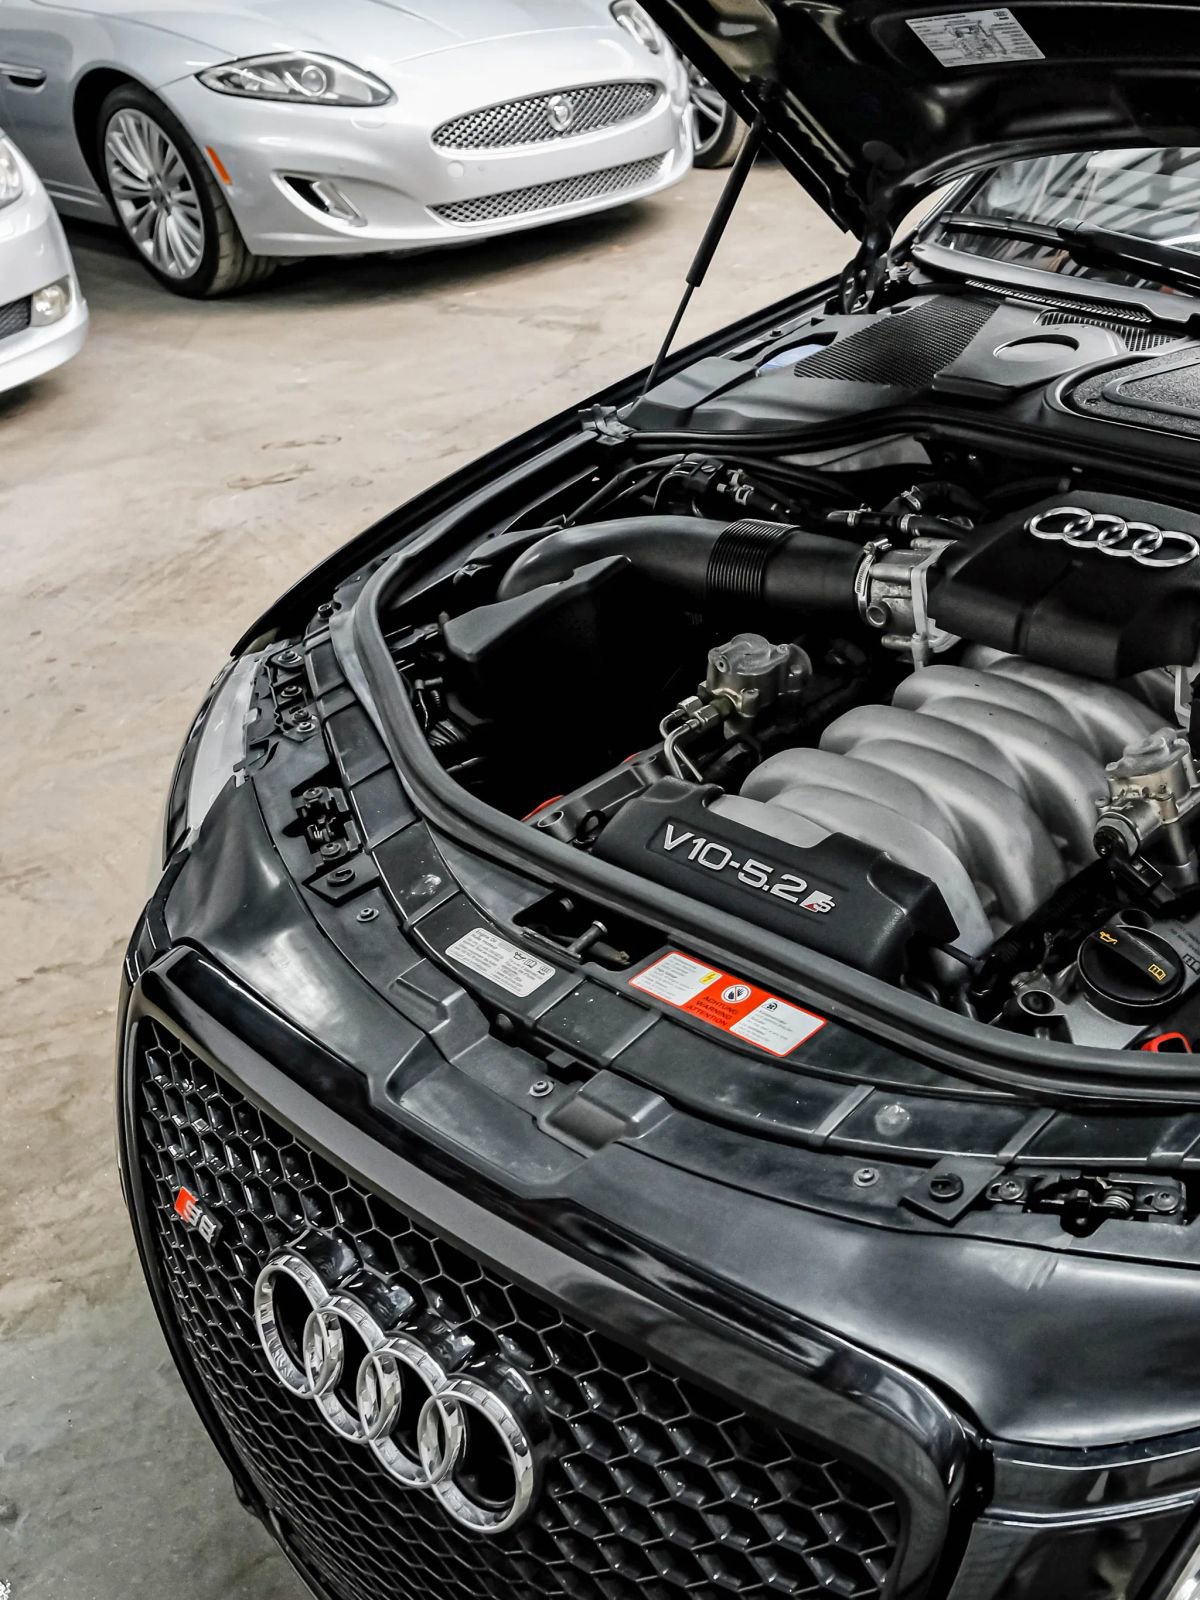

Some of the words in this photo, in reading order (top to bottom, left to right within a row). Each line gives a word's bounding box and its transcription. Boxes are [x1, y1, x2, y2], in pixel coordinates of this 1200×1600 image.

[687, 1005, 727, 1025] ATTENTION
[696, 1000, 733, 1020] WARNING
[704, 996, 738, 1015] ACHTUNG
[179, 1195, 217, 1244] S8
